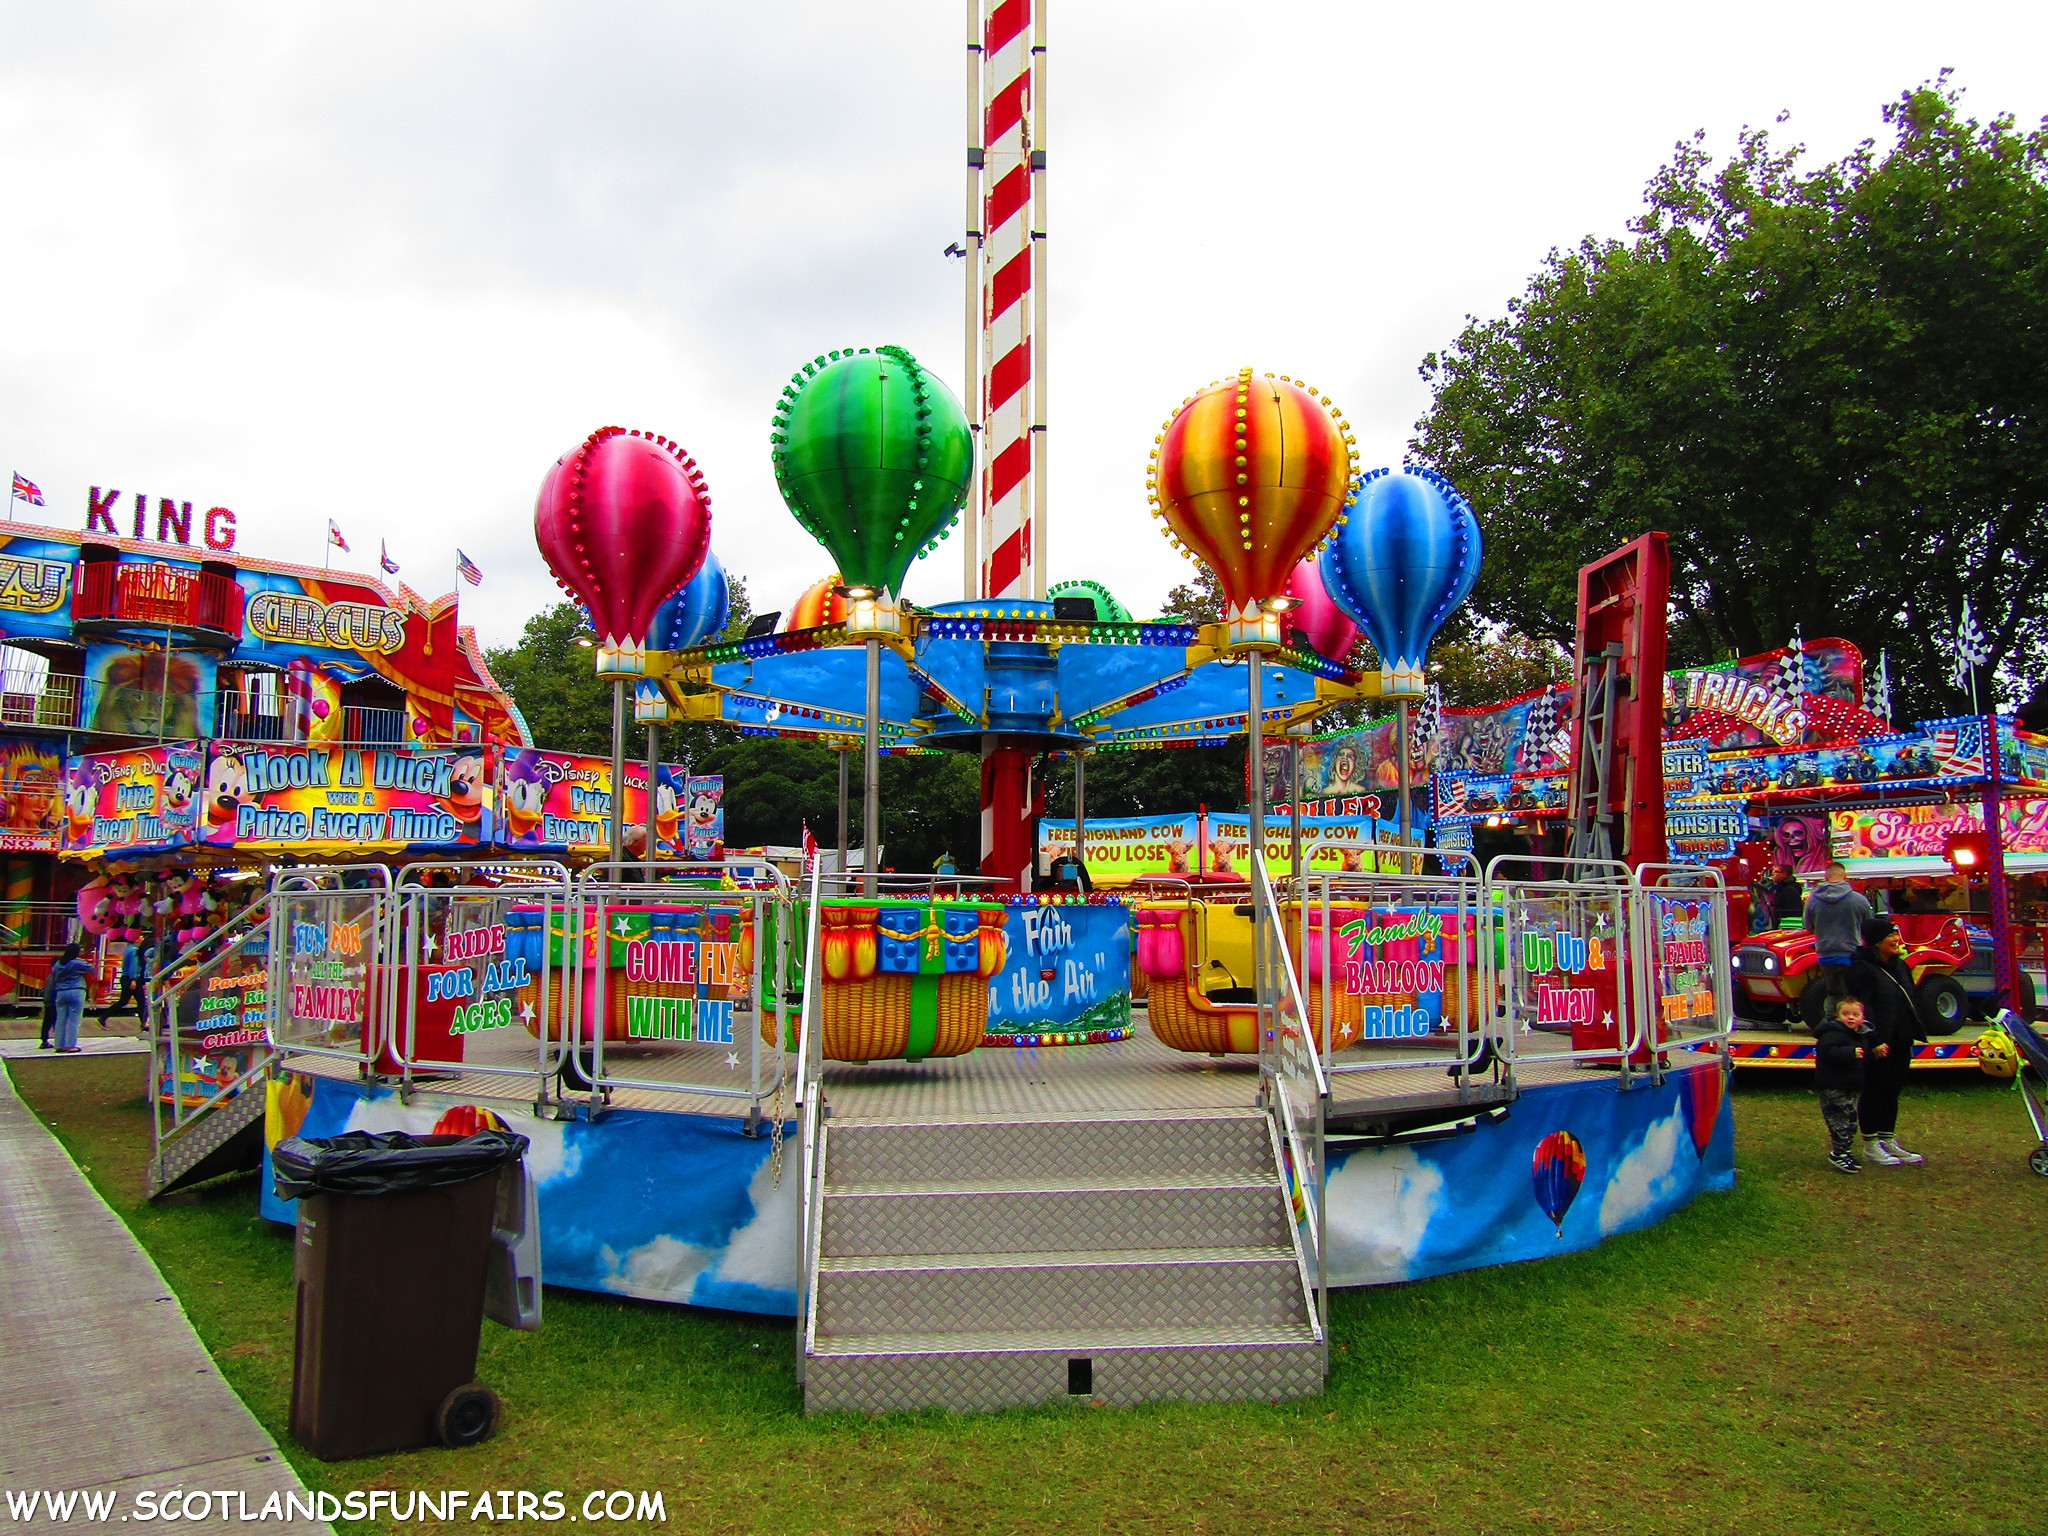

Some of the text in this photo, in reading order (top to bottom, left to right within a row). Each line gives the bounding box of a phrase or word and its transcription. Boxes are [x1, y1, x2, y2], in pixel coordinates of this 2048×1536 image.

[86, 484, 237, 551] KING
[248, 591, 406, 655] CIRCUS
[1686, 670, 1808, 745] TRUCKS
[138, 752, 166, 775] Duc
[244, 750, 453, 798] Hook A Duck
[1662, 755, 1703, 773] STER
[116, 782, 155, 811] Prize
[326, 791, 376, 806] WIN A
[571, 786, 611, 814] Priz
[691, 780, 721, 792] Quality
[92, 816, 134, 844] Every
[165, 811, 193, 825] Prizes
[236, 805, 458, 841] Prize Every Time
[543, 814, 599, 845] Every
[694, 827, 718, 837] Prizes
[1048, 824, 1184, 841] FREE HIGHLAND COW
[1217, 824, 1247, 838] FREE
[1324, 826, 1359, 839] COW
[1084, 845, 1120, 861] YOU
[1126, 845, 1165, 861] LOSE
[1237, 844, 1249, 859] IF
[1263, 844, 1292, 861] OU
[1674, 838, 1727, 853] TRUCKS
[296, 921, 361, 957] FUN FOR
[1022, 908, 1076, 956] Fair
[1340, 908, 1442, 958] Family
[1662, 913, 1685, 937] See
[448, 924, 505, 961] RIDE
[1523, 931, 1605, 975] Up Up &
[1664, 940, 1706, 967] FAIR
[311, 961, 344, 980] ALL THE
[625, 940, 739, 986] COME FLY
[1345, 960, 1444, 994] BALLOON
[208, 970, 268, 991] Parent
[427, 957, 531, 1001] FOR ALL
[1012, 967, 1052, 1015] the
[200, 996, 238, 1011] May
[293, 985, 361, 1023] FAMILY
[449, 998, 512, 1035] AGES
[1537, 984, 1594, 1026] Away
[1661, 990, 1714, 1022] THE AIR
[196, 1013, 236, 1031] with
[627, 996, 734, 1044] WITH ME
[1364, 1004, 1429, 1039] Ride
[203, 1028, 268, 1049] Childre
